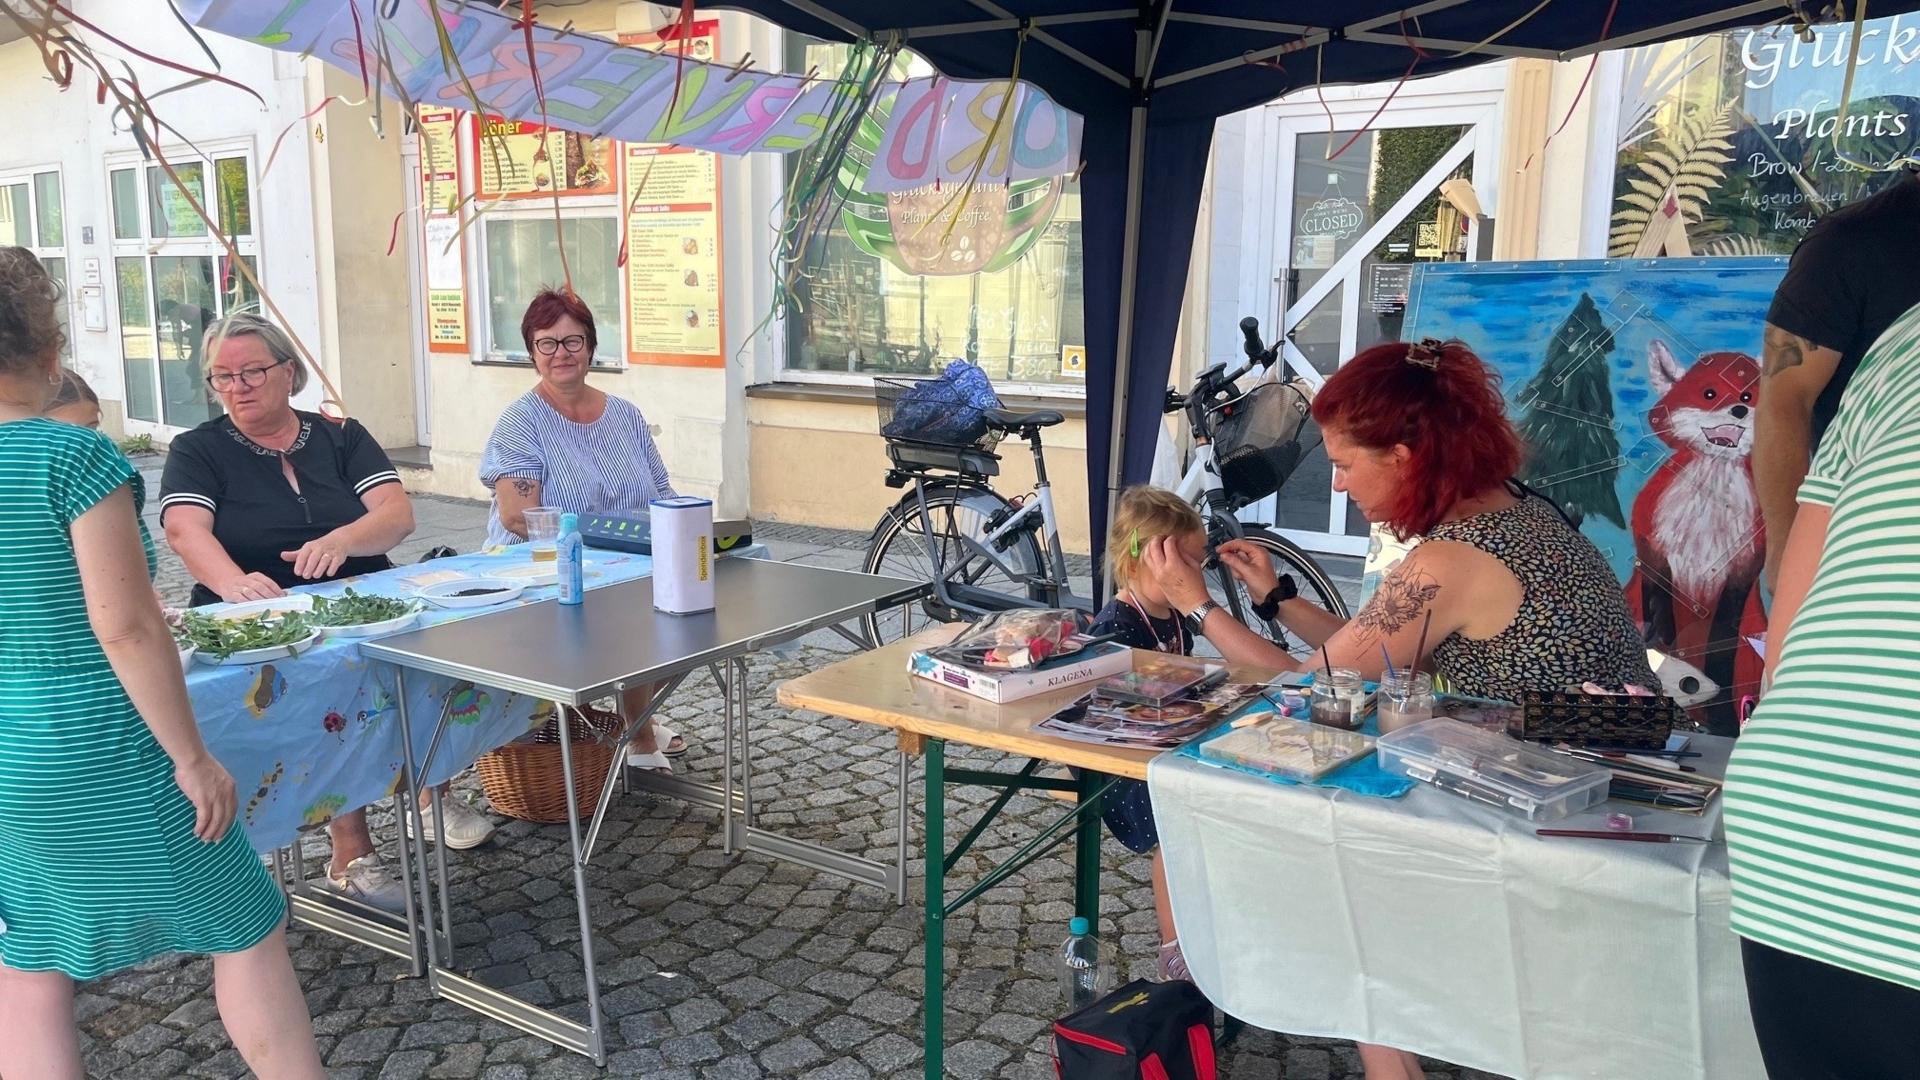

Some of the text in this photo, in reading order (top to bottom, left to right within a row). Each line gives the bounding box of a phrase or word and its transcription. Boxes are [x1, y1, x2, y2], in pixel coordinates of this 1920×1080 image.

[1741, 15, 1920, 90] Glück
[483, 119, 522, 136] öner
[1773, 99, 1909, 140] Plants
[314, 122, 324, 144] 4
[1747, 152, 1803, 178] Brow
[1740, 186, 1848, 212] Augenbrauen
[941, 210, 953, 223] &
[956, 205, 990, 229] Coffee
[1305, 213, 1358, 233] CLOSED
[700, 535, 708, 582] Spendenbox
[1047, 668, 1093, 687] KLAGENA
